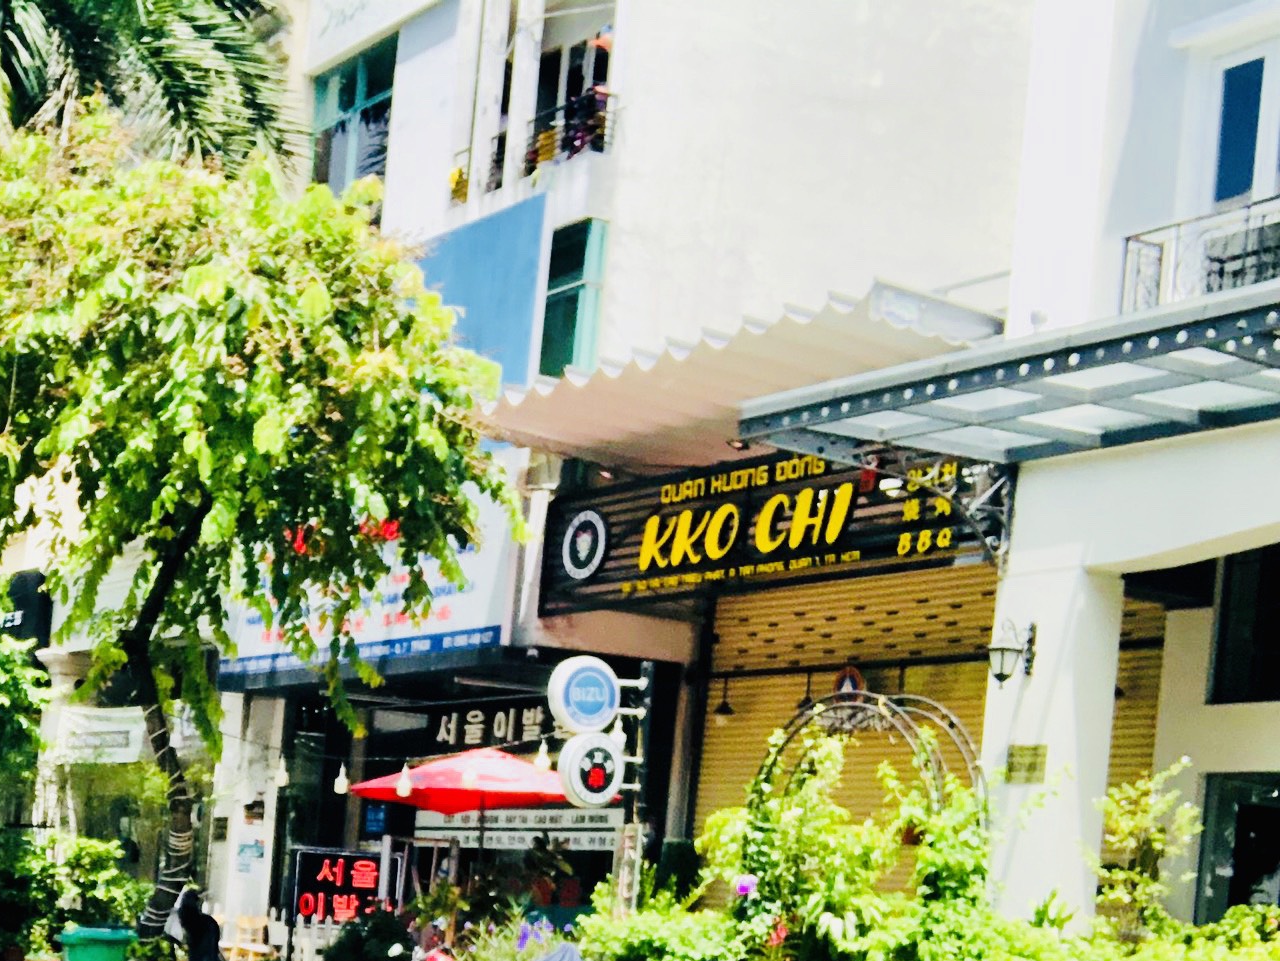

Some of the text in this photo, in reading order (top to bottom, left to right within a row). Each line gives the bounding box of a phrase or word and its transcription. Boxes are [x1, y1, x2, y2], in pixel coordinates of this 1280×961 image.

[638, 503, 739, 572] KKO
[755, 482, 853, 554] CHI
[316, 858, 378, 889] 서울
